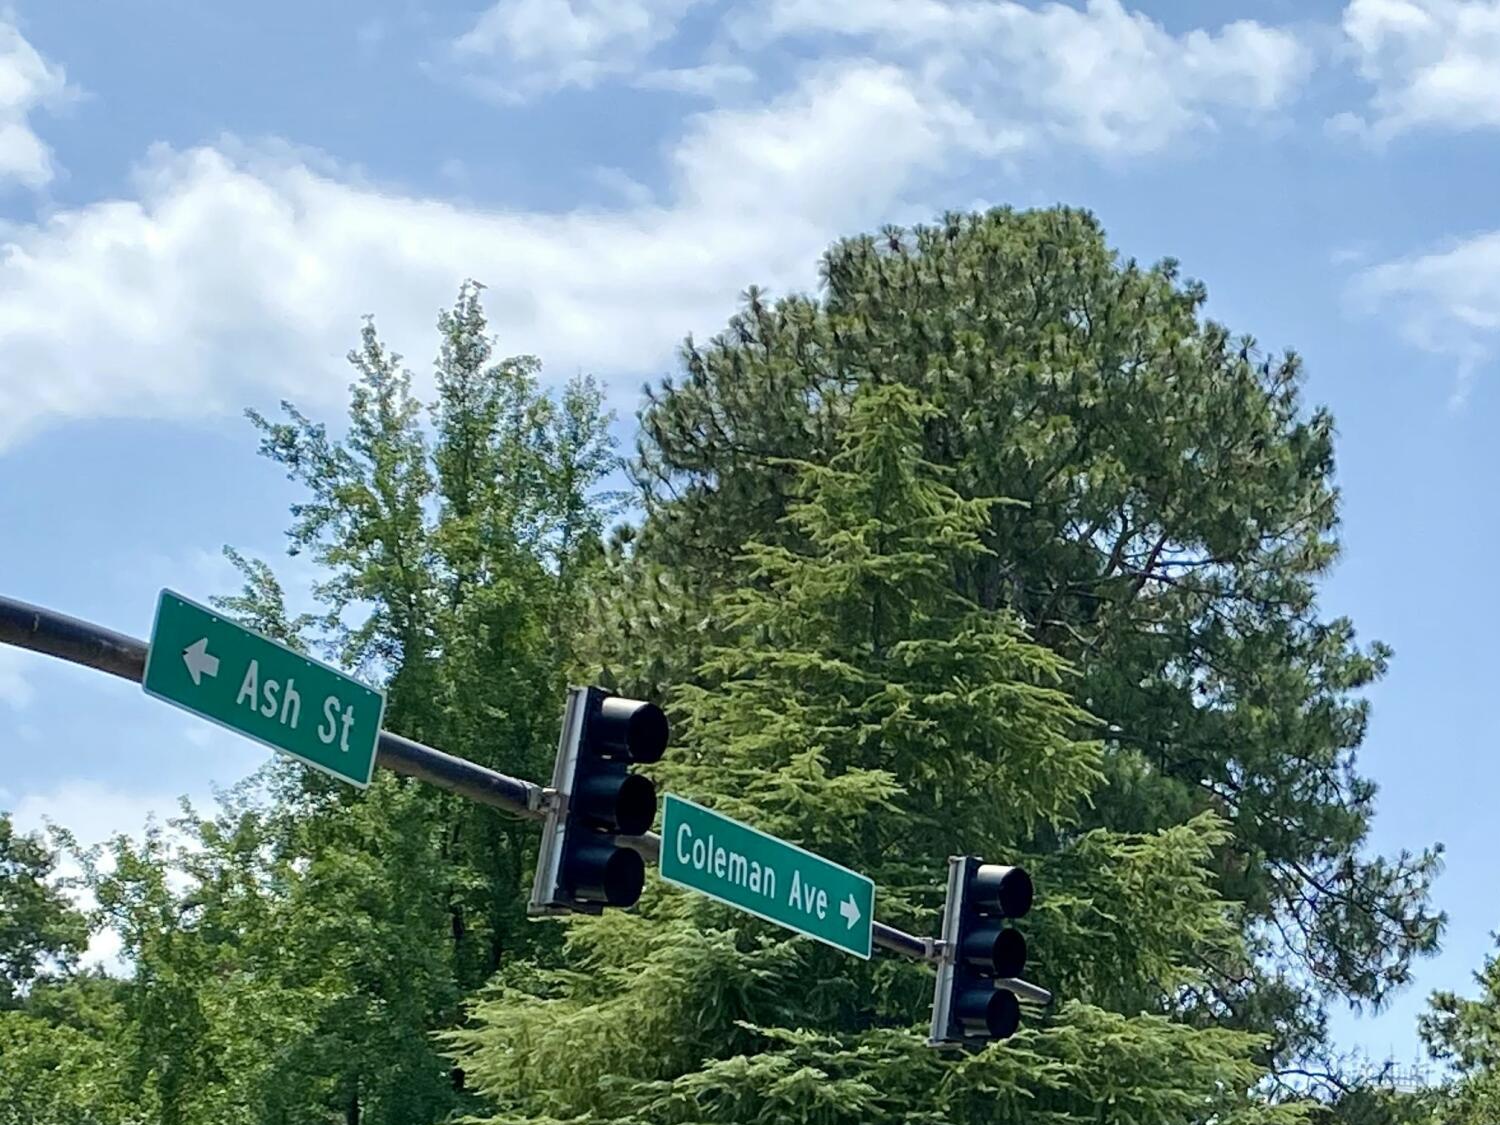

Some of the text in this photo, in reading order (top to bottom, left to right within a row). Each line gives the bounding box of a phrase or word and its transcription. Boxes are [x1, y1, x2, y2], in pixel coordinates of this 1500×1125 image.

[236, 659, 355, 752] Ash St
[676, 822, 828, 920] Coleman Ave
